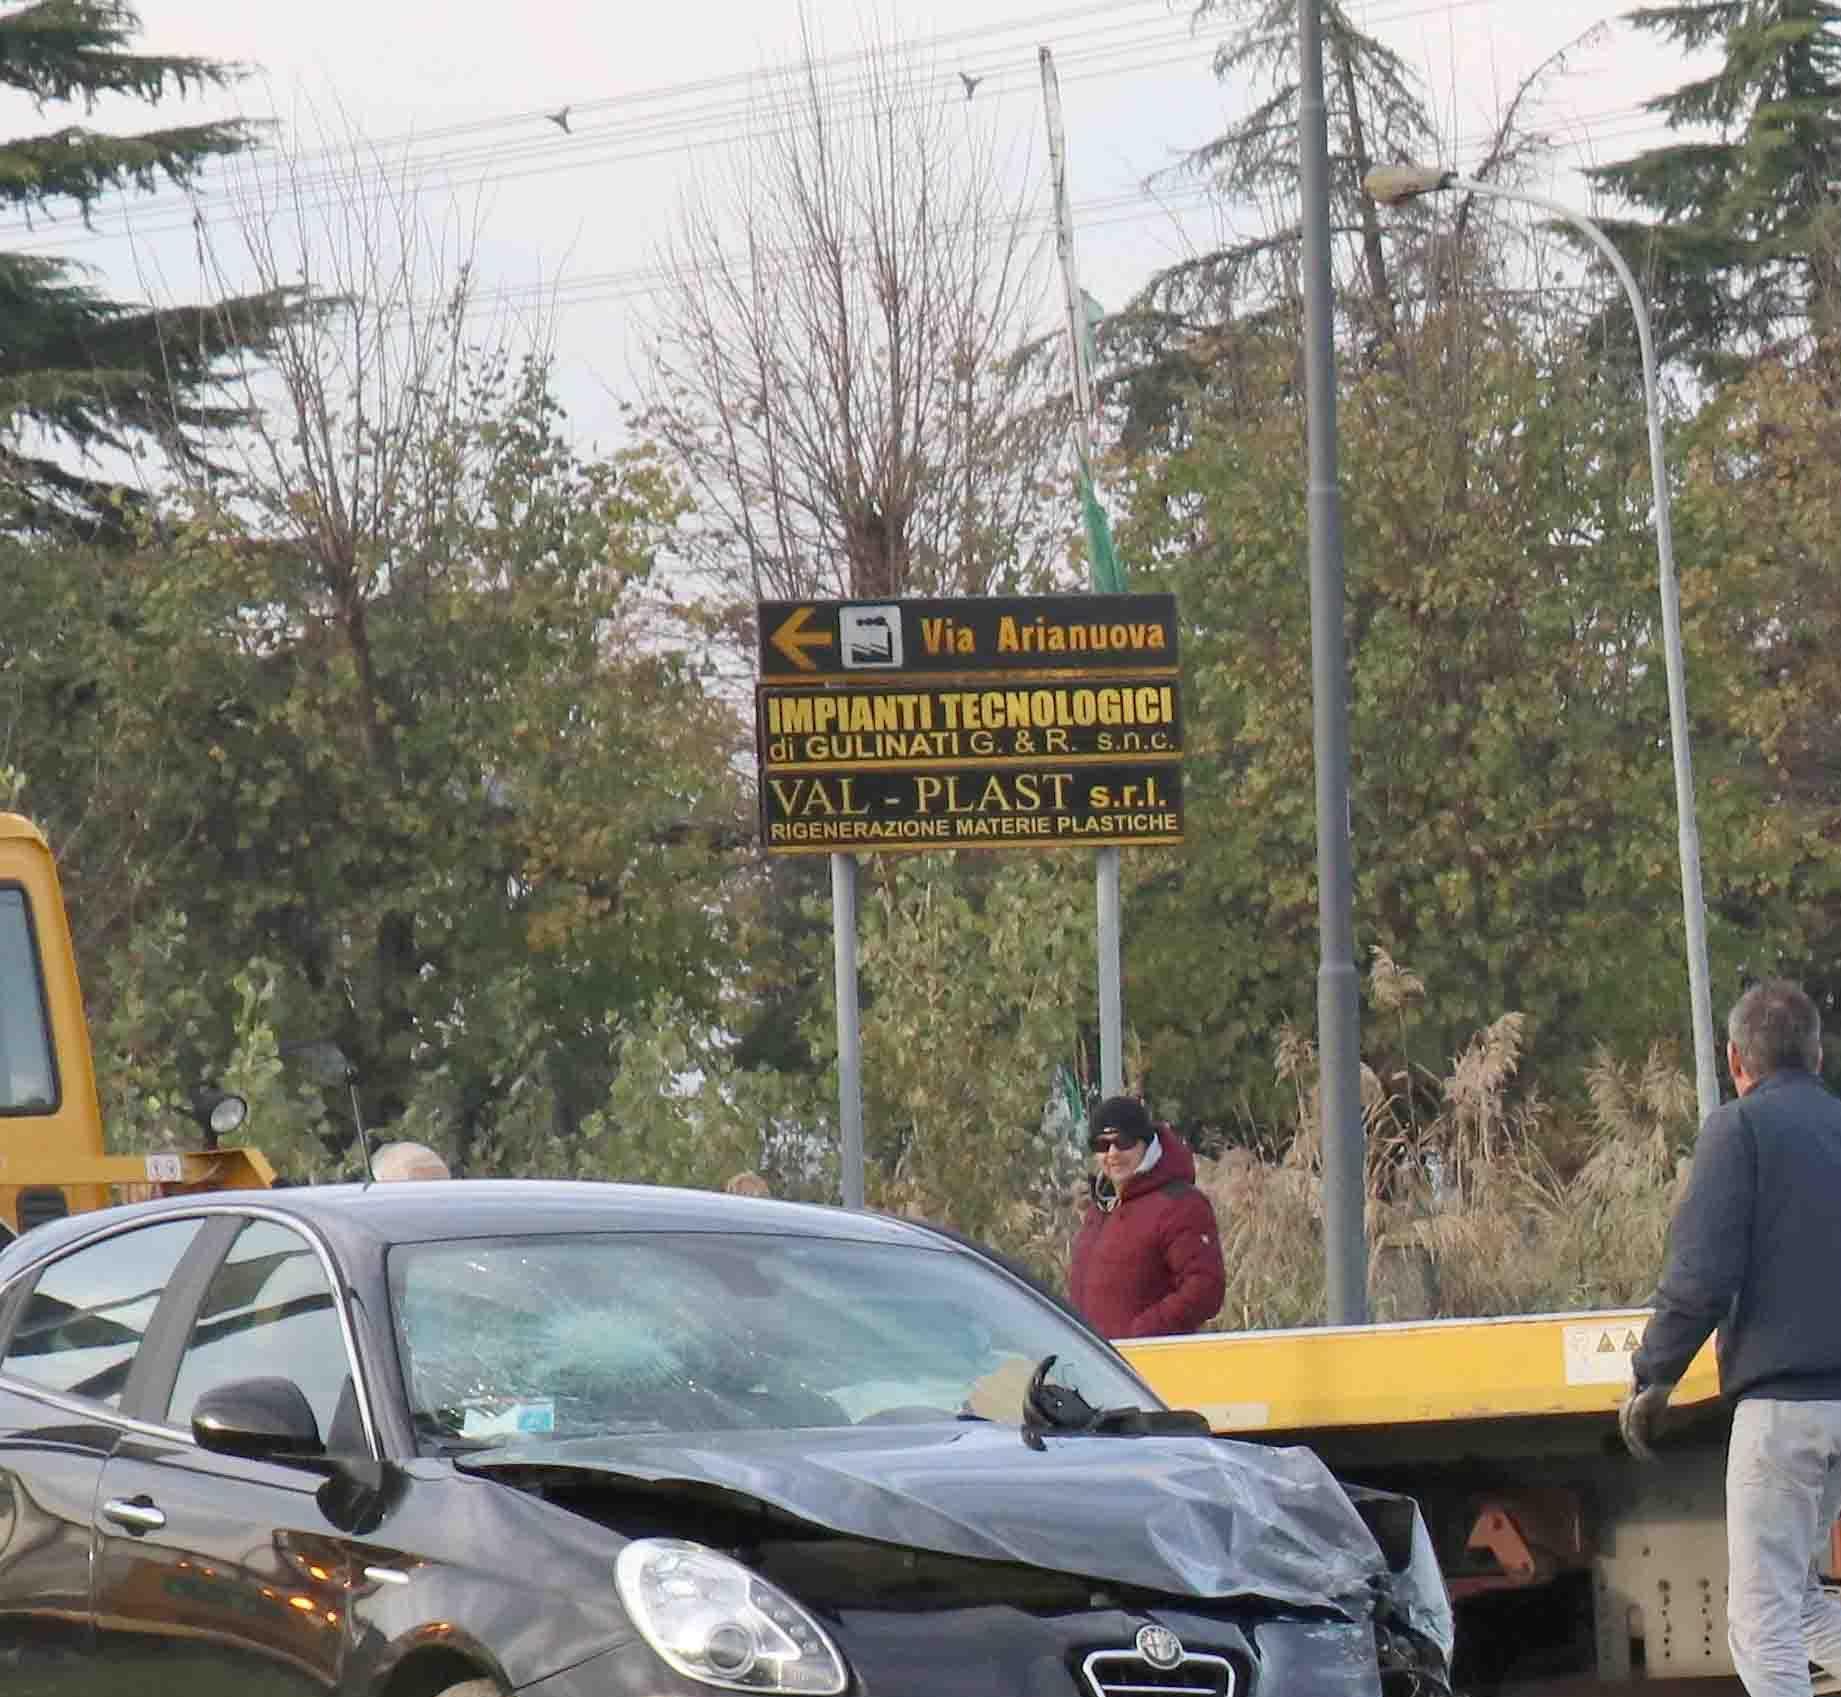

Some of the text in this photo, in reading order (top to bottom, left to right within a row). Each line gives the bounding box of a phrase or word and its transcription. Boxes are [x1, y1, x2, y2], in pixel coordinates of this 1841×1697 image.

[920, 615, 1166, 655] Via Arianuova
[768, 687, 1174, 734] IMPIANTI TECNOLOGICI
[769, 728, 1175, 762] di GULINATI G. & R. s.n.c.
[768, 778, 871, 817] VAL
[913, 772, 1073, 814] PLAST
[1089, 776, 1168, 808] s.r.l.
[770, 813, 1178, 841] RIGENERAZIONE MATERIE PLASTICHE
